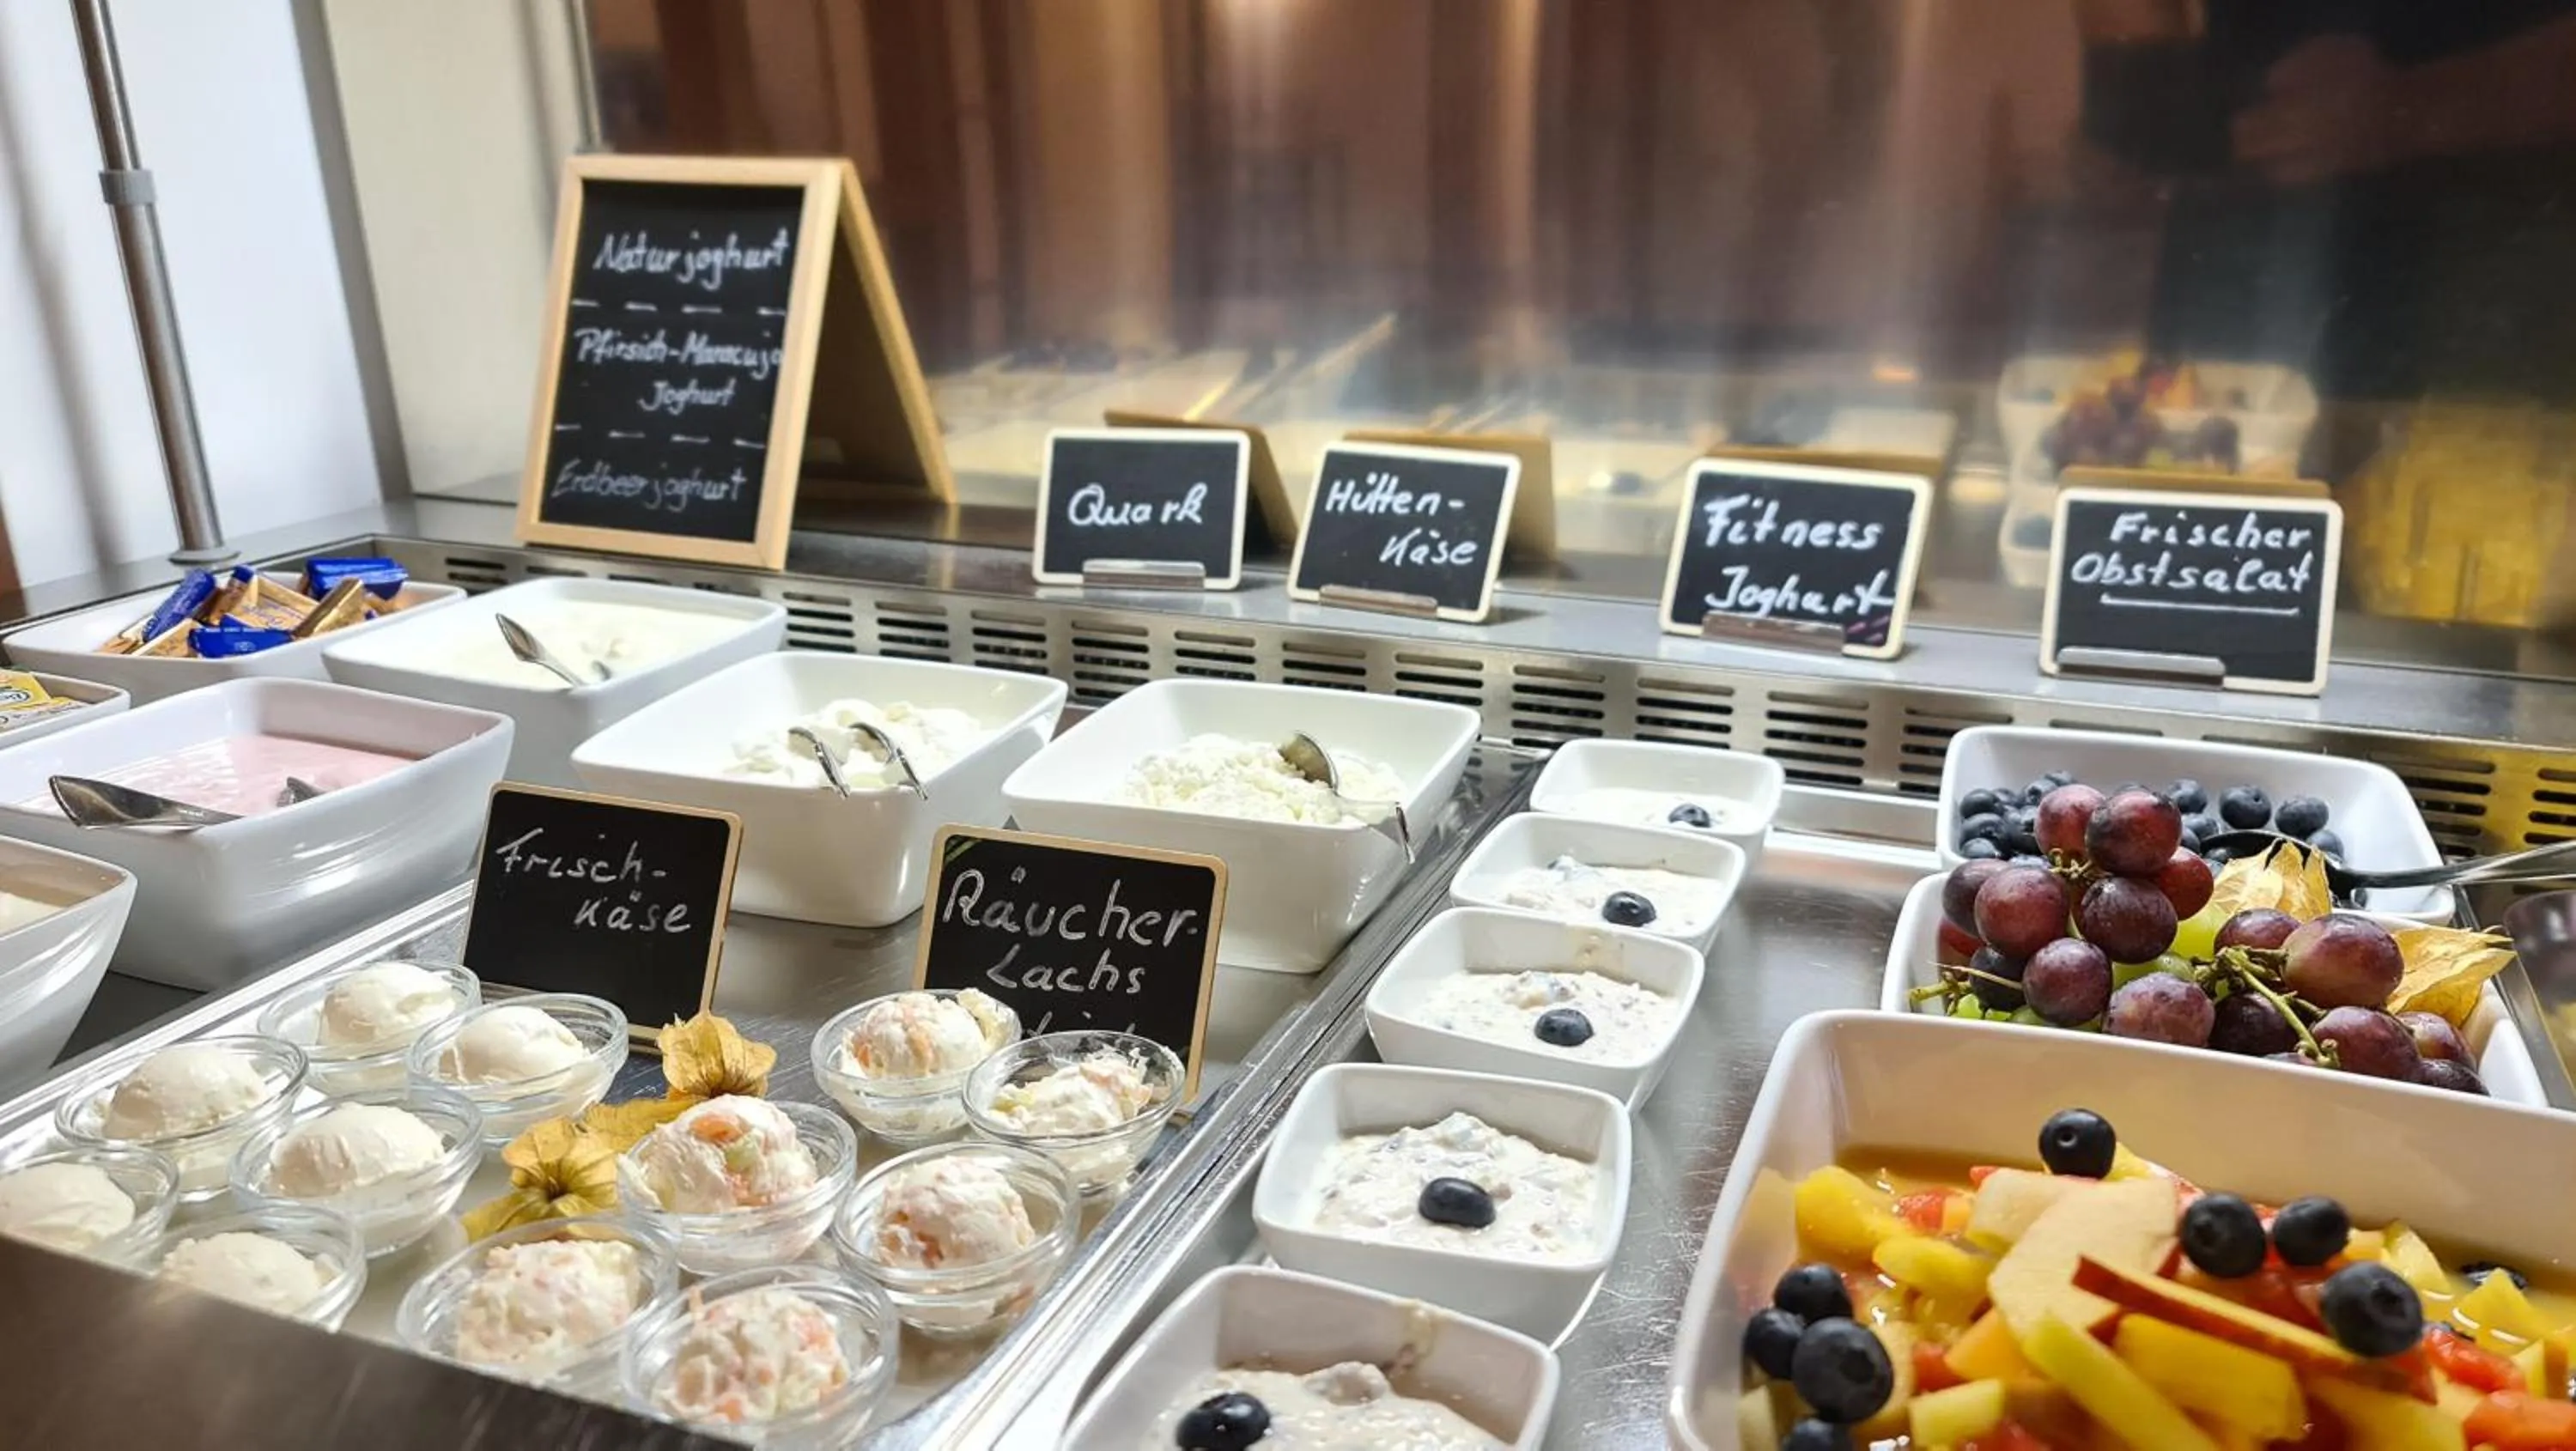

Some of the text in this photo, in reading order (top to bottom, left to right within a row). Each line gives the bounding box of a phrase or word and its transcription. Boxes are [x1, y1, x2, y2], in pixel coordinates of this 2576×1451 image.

[637, 378, 736, 414] Joghurt
[1068, 483, 1208, 525] Quark
[1325, 472, 1465, 515] Hütten-
[1704, 494, 1884, 549] Fitness
[2110, 510, 2312, 549] Frischer
[1379, 526, 1479, 567] Käse
[1704, 565, 1895, 618] Joghurt
[2071, 550, 2314, 592] Obstsalat
[496, 827, 666, 883] Frisch-
[573, 889, 690, 932] Käse
[987, 944, 1145, 994] Lachs
